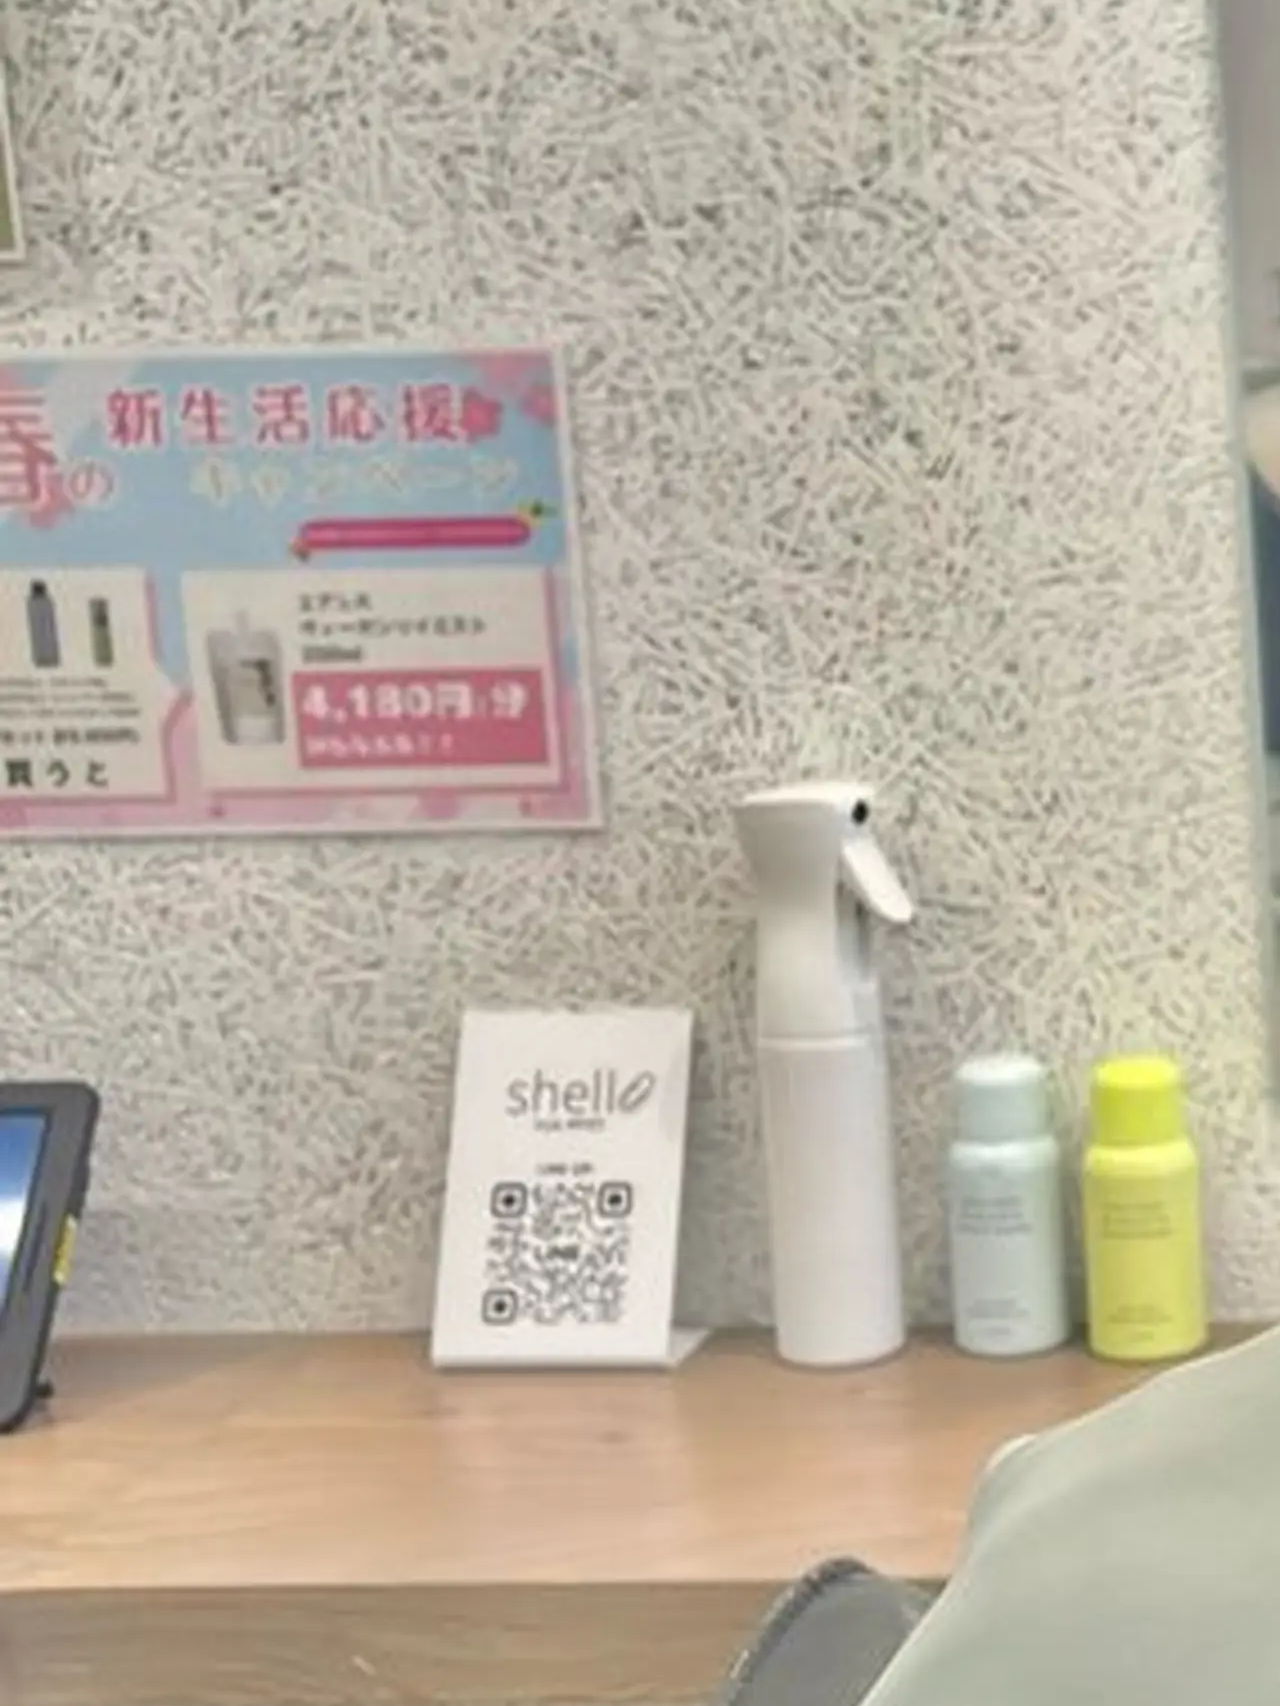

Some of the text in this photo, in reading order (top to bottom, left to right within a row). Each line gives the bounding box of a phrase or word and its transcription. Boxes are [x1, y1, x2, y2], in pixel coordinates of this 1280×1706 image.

[107, 384, 460, 447] 新生活応援
